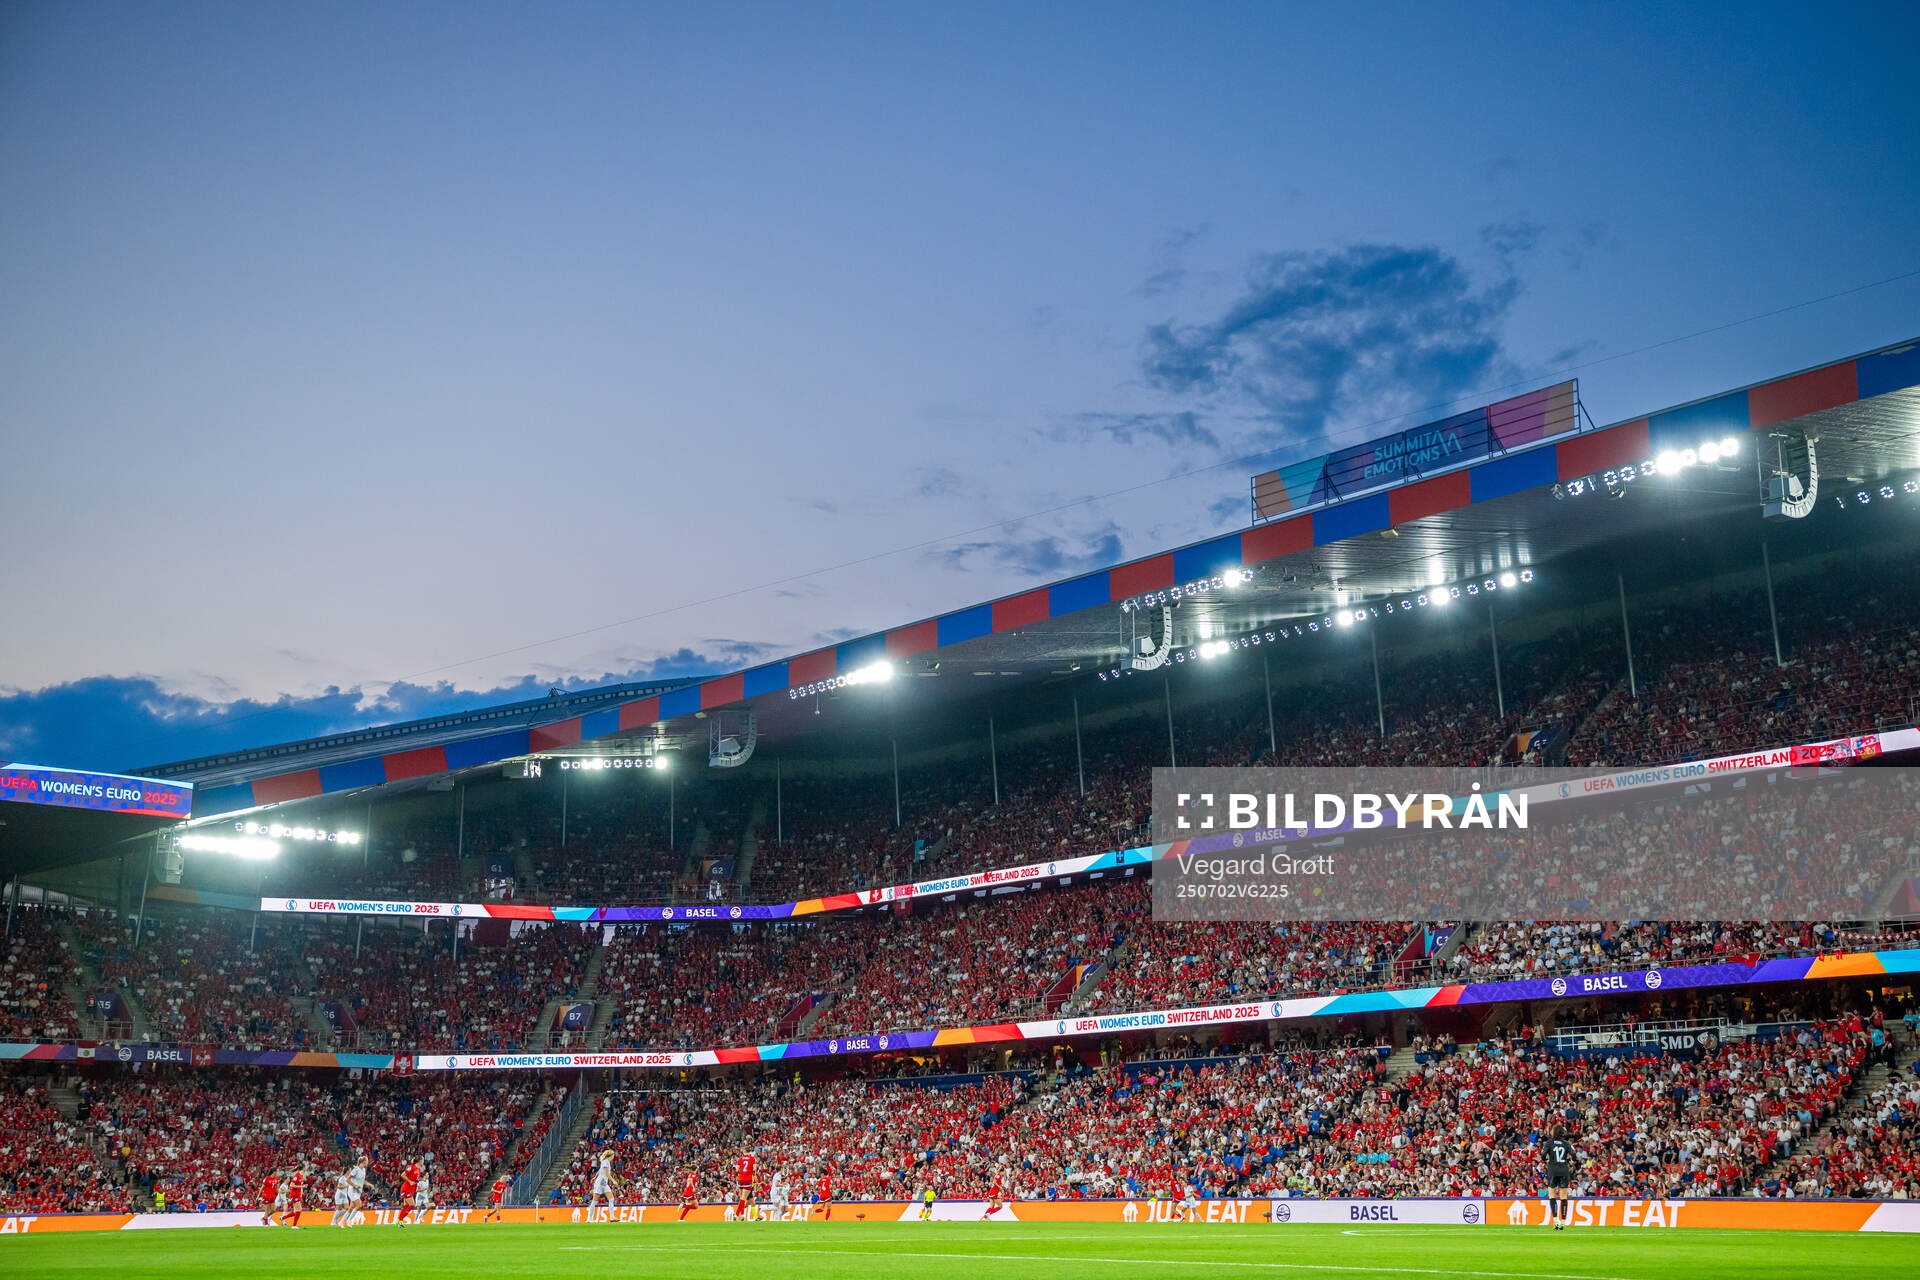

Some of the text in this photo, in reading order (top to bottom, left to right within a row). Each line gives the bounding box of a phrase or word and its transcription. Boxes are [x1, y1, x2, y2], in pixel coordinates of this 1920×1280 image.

[1364, 445, 1441, 480] EMOTIONS
[1584, 778, 1615, 793] UEFA
[1616, 769, 1670, 788] WOMEN'S
[1673, 764, 1705, 780] EURO
[1708, 749, 1798, 774] SWITZERLAND
[1, 776, 177, 805] UEFA WOMEN'S EURO 2025
[1255, 828, 1286, 843] BASEL
[919, 880, 950, 893] WOMEN'S
[951, 878, 969, 889] EURO
[1020, 867, 1040, 878] 2025
[308, 901, 439, 914] UEFA WOMEN'S EURO 2025
[686, 908, 718, 918] BASEL
[1583, 976, 1628, 991] BASEL
[1076, 1005, 1260, 1032] UEFA WOMEN'S EURO SWITZERLAND 2025
[846, 1039, 870, 1051] BASEL
[1660, 1034, 1695, 1051] SMD
[147, 1050, 184, 1062] BASEL
[469, 1055, 672, 1066] UEFA WOMEN'S EURO SWITZERLAND 2025
[1553, 1146, 1565, 1163] 12
[743, 1160, 749, 1172] 2
[431, 1208, 473, 1225] EAT
[619, 1206, 647, 1223] EAT
[1206, 1200, 1252, 1223] EAT
[1350, 1205, 1399, 1221] BASEL
[1622, 1200, 1686, 1228] EAT
